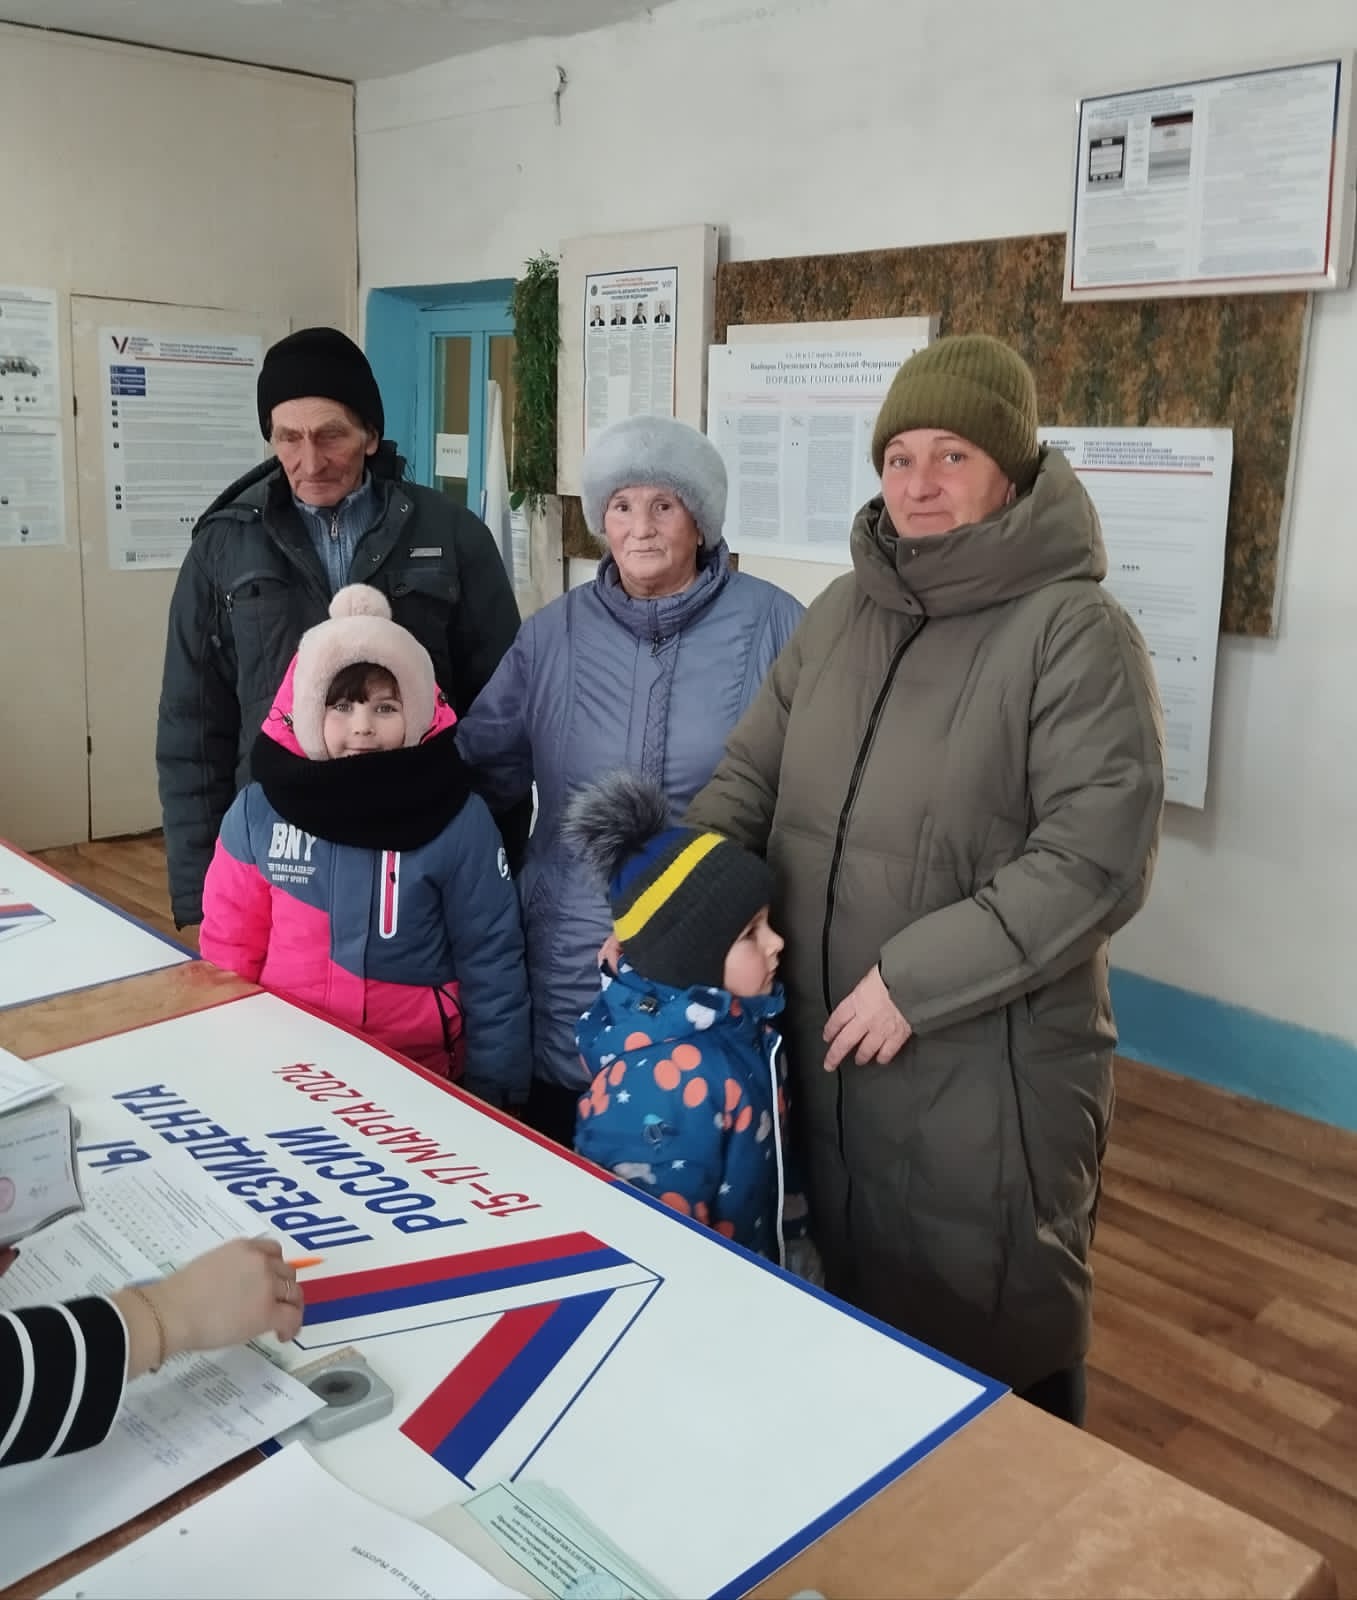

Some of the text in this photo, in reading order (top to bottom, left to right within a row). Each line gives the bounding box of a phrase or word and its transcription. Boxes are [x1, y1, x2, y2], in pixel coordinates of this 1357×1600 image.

[268, 822, 318, 862] BNY
[271, 1062, 358, 1103] 2024
[331, 1101, 457, 1164] МАРТА
[111, 1083, 375, 1251] ПРЕЗИДЕНТА
[265, 1125, 468, 1235] РОССИИ
